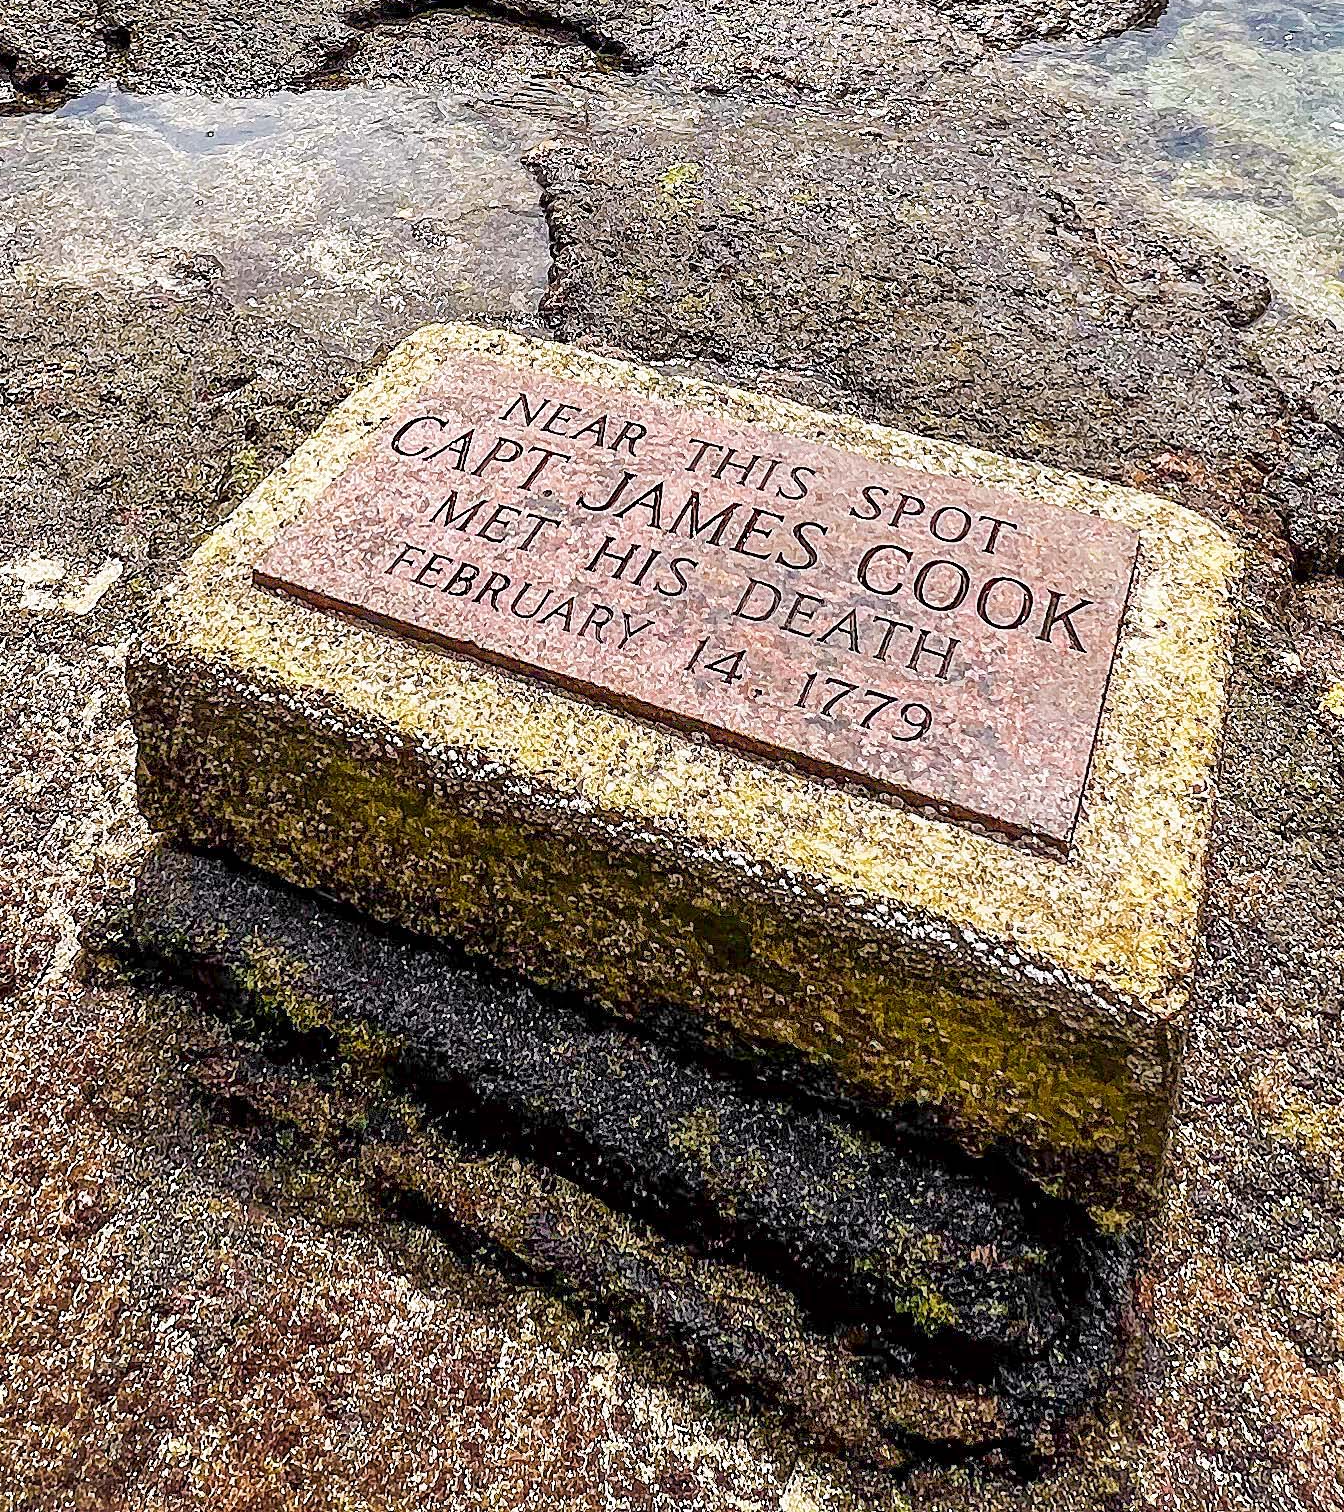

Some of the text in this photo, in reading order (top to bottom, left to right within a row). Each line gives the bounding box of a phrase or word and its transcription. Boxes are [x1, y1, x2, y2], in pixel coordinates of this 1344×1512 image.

[391, 415, 1094, 654] CAPT. JAMES COOK
[499, 393, 1018, 555] NEAR THIS SPOT
[384, 542, 655, 649] FEBRUARY
[794, 672, 933, 742] 1779
[429, 490, 961, 680] MET HIS DEATH
